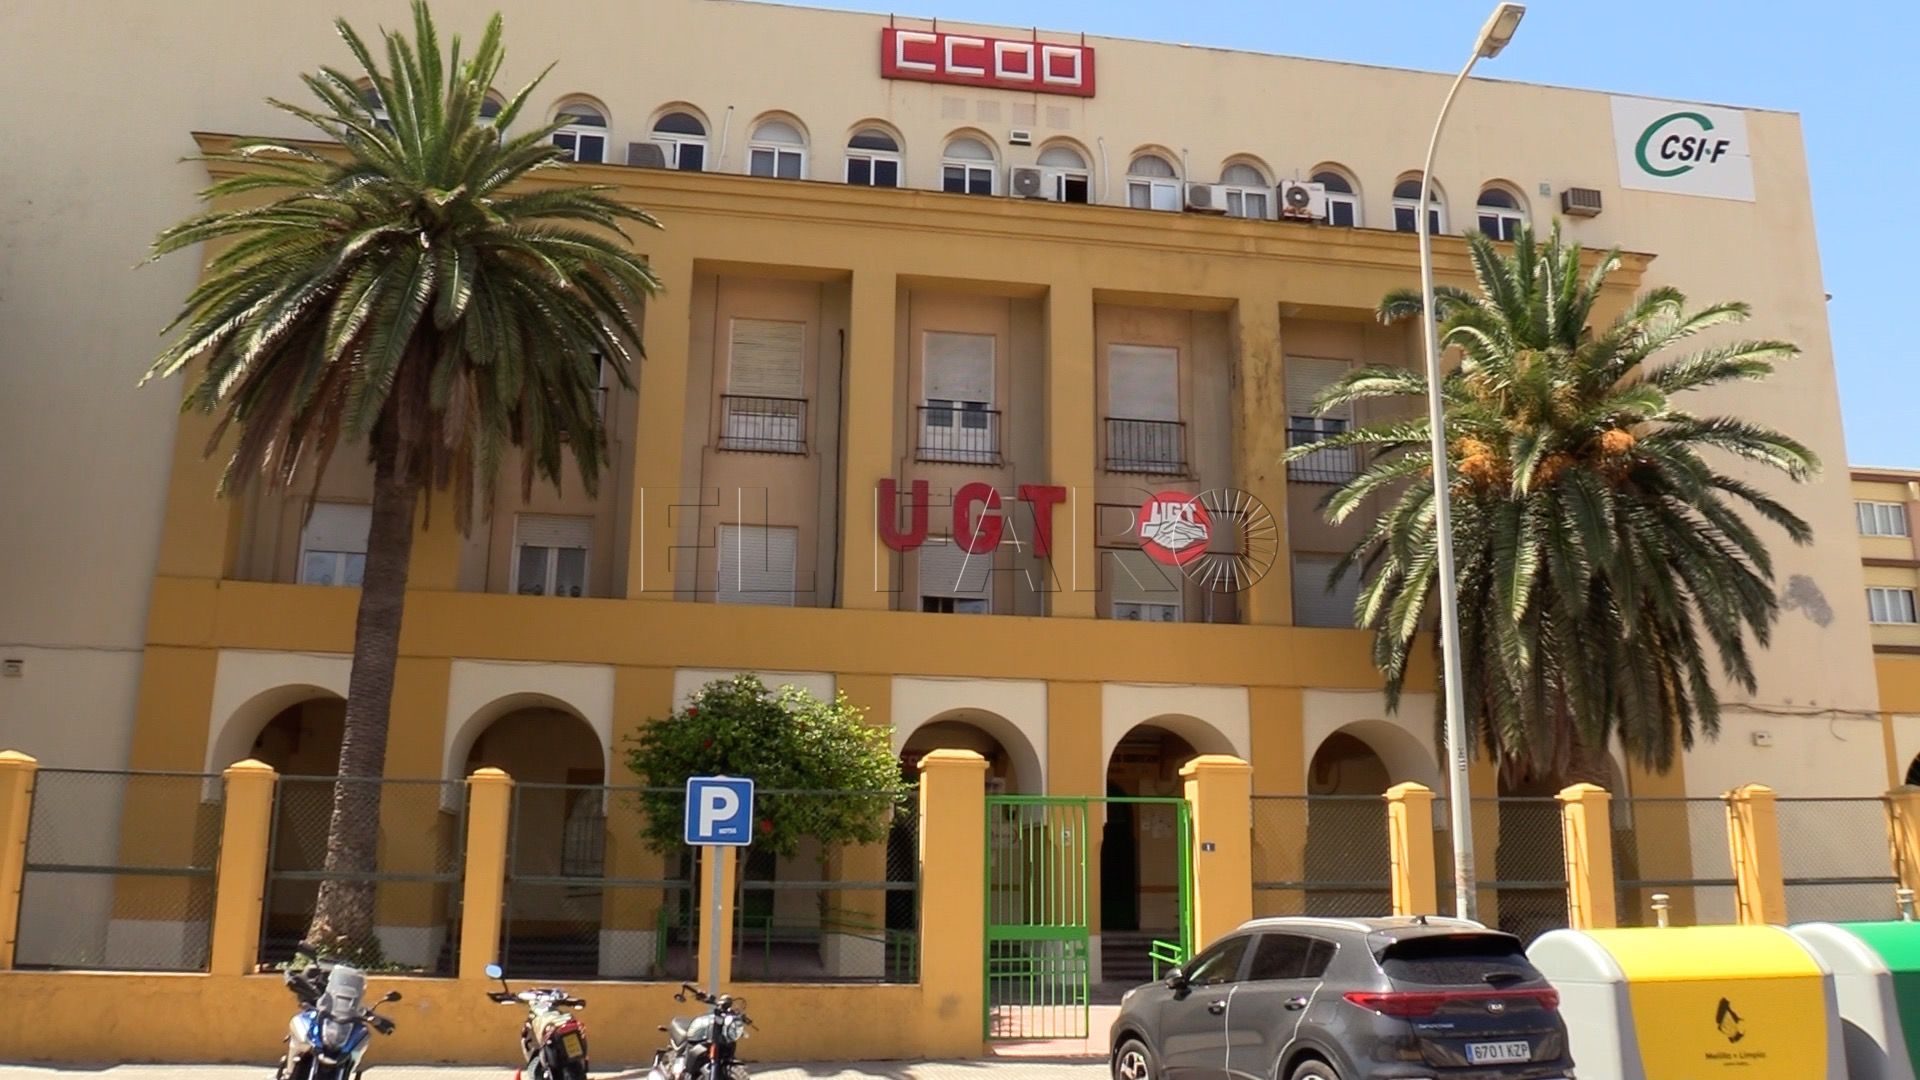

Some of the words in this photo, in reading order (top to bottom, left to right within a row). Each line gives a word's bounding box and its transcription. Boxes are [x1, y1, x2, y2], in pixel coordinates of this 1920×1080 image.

[895, 30, 1082, 85] CCOO
[879, 478, 1067, 559] UGT
[1150, 501, 1197, 523] UGT
[698, 785, 740, 837] P
[1473, 1044, 1505, 1060] 6701
[1506, 1043, 1529, 1058] KZP
